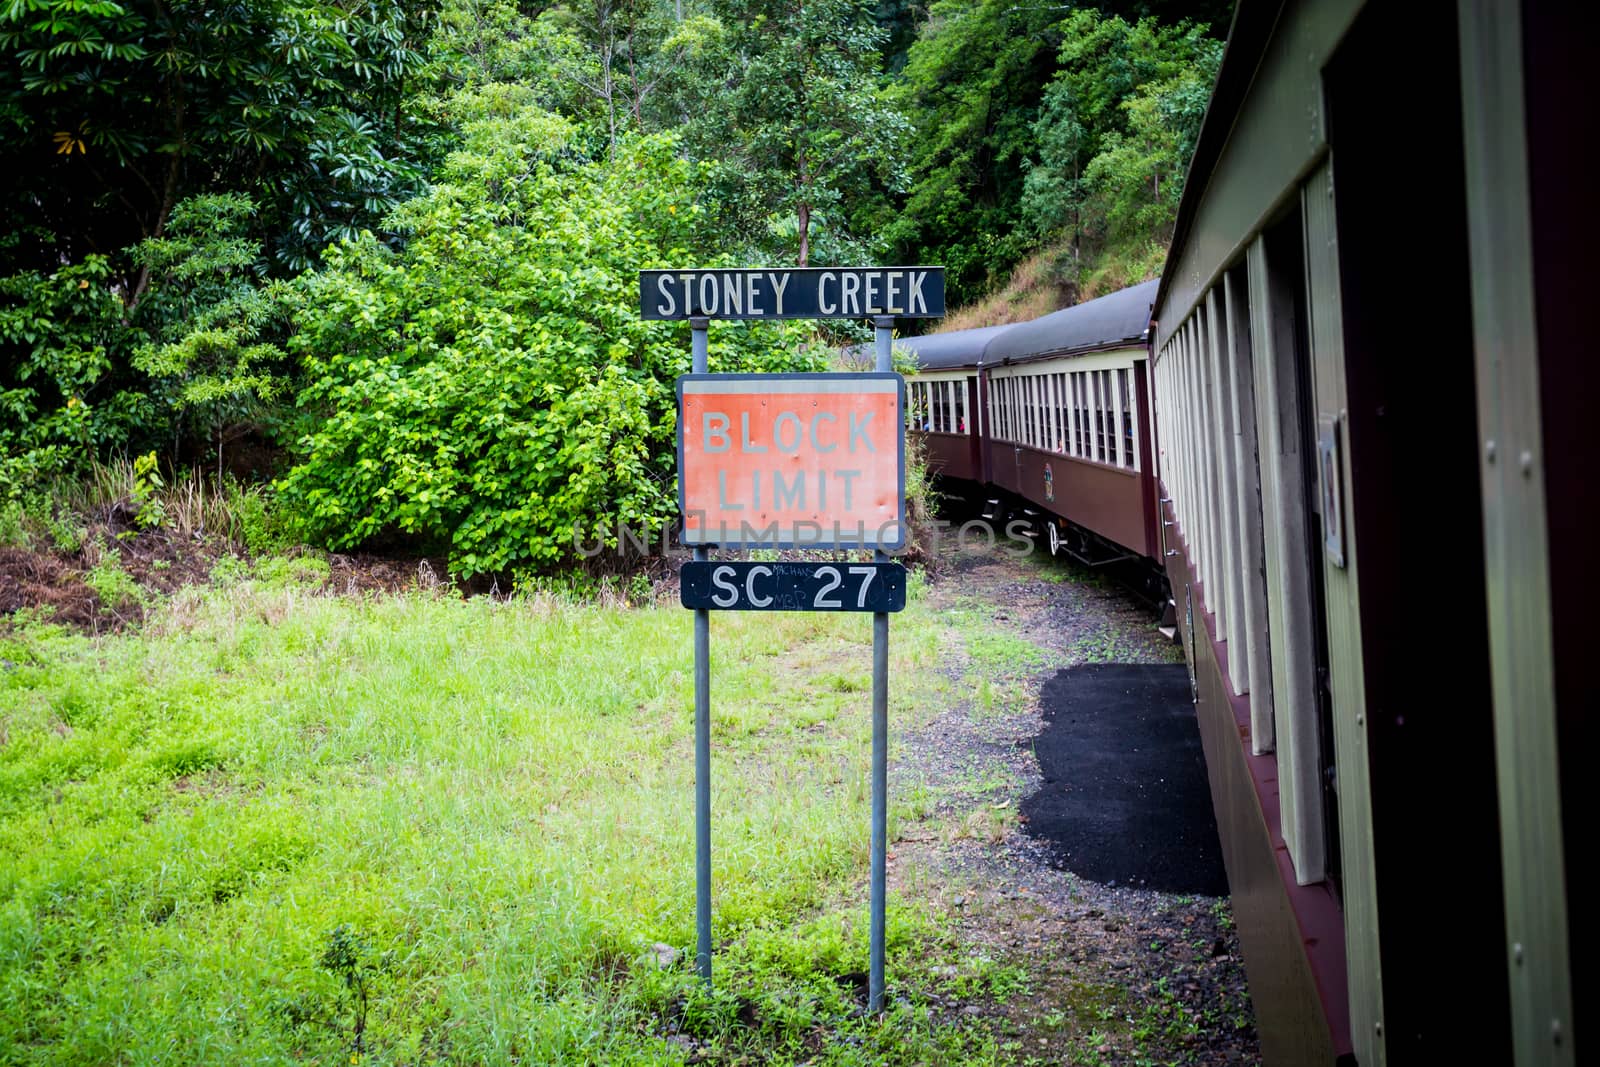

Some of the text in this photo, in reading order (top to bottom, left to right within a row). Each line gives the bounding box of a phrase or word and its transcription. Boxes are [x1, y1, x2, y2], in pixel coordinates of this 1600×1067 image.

[657, 271, 928, 316] STONEY CREEK
[702, 411, 877, 454] BLOCK
[718, 469, 862, 512] LIMIT
[711, 565, 877, 608] SC 27
